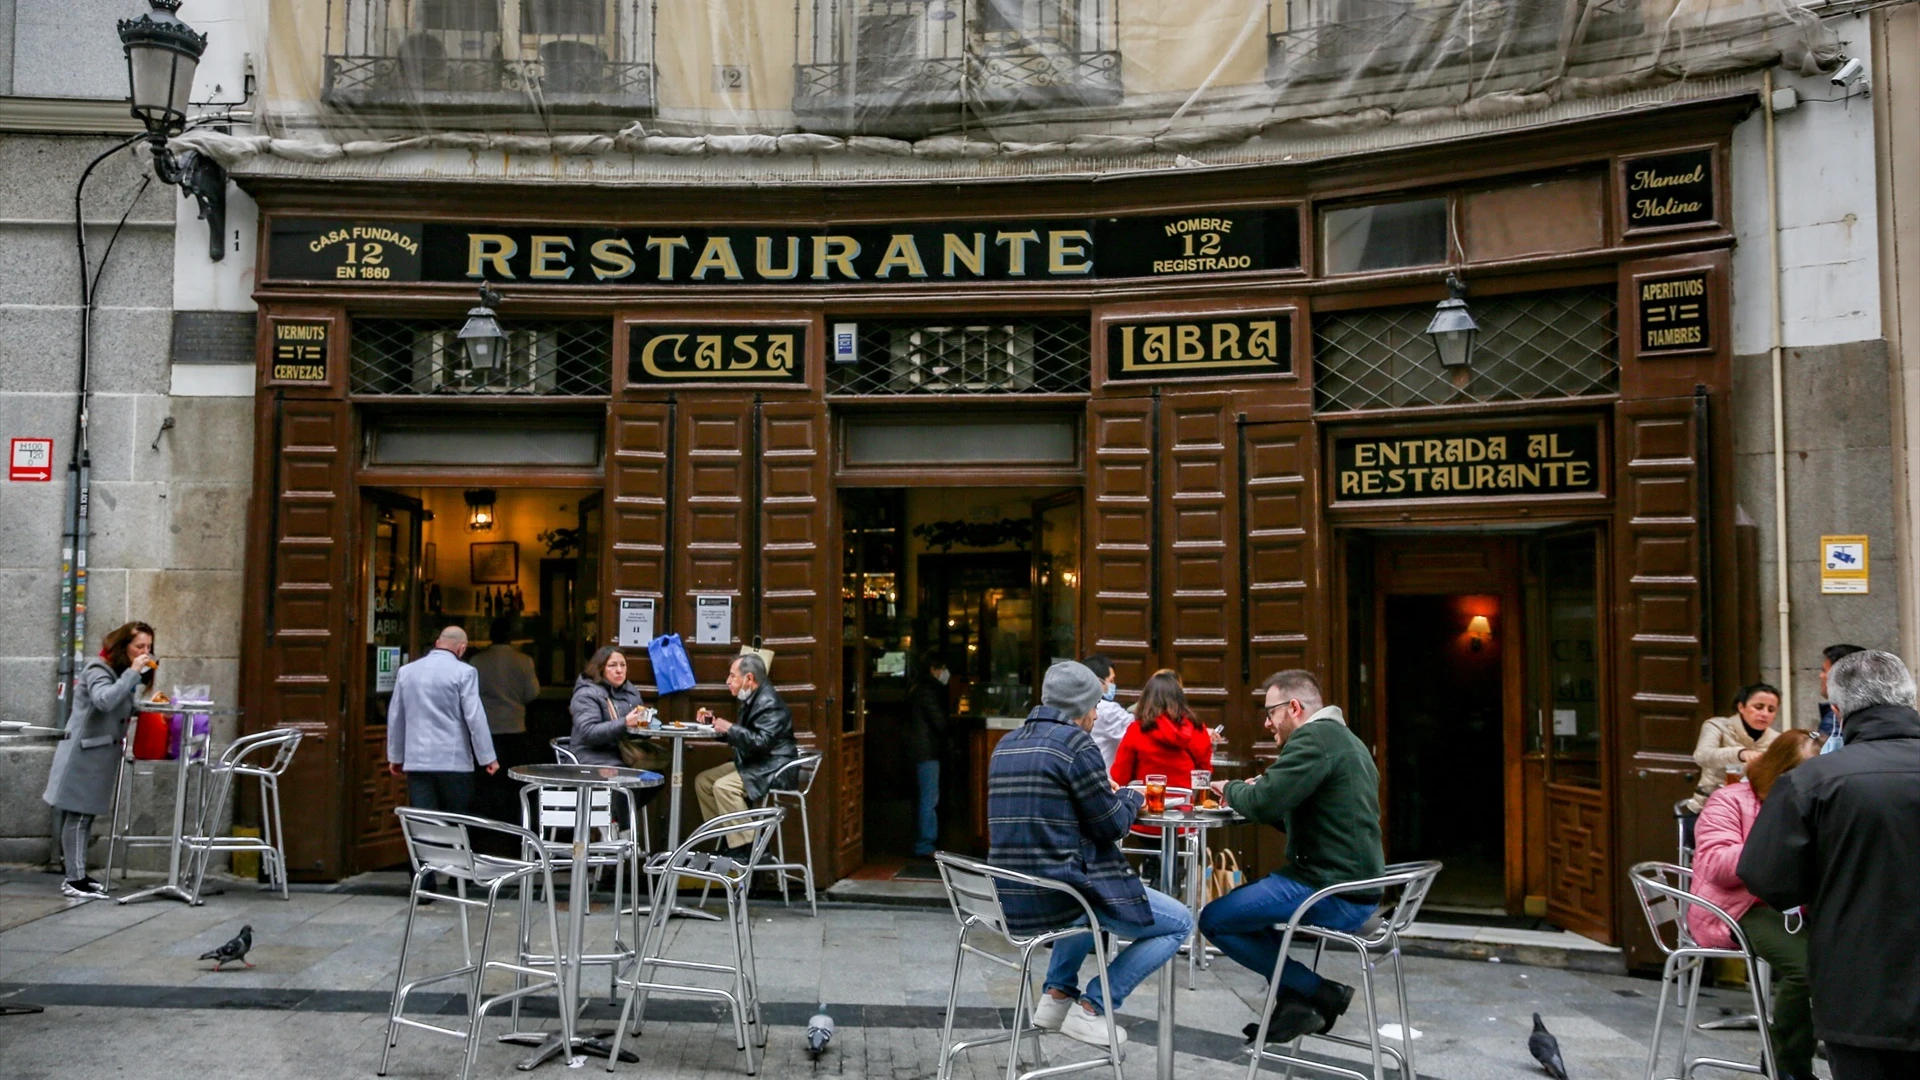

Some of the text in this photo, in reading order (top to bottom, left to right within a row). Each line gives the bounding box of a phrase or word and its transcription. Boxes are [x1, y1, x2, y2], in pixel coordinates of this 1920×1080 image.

[1630, 164, 1705, 190] Manuel
[1632, 197, 1702, 219] Molina
[1164, 218, 1234, 237] NOMBRE
[309, 227, 419, 256] CASA FUNDADA
[1182, 233, 1221, 256] 12
[345, 242, 384, 265] 12
[465, 229, 1094, 281] RESTAURANTE
[1153, 255, 1251, 273] REGISTRADO
[336, 266, 391, 279] EN 1860
[1642, 279, 1704, 301] APERITIVOS
[1669, 305, 1677, 321] Y
[277, 325, 325, 340] VERMUTS
[1647, 326, 1702, 347] FIAMBRES
[296, 345, 304, 360] Y
[641, 333, 795, 378] CASA
[1121, 320, 1279, 373] LABRA
[274, 364, 325, 380] CERVEZAS
[1355, 433, 1575, 468] ENTRADA AL
[1341, 461, 1592, 495] RESTAURANTE
